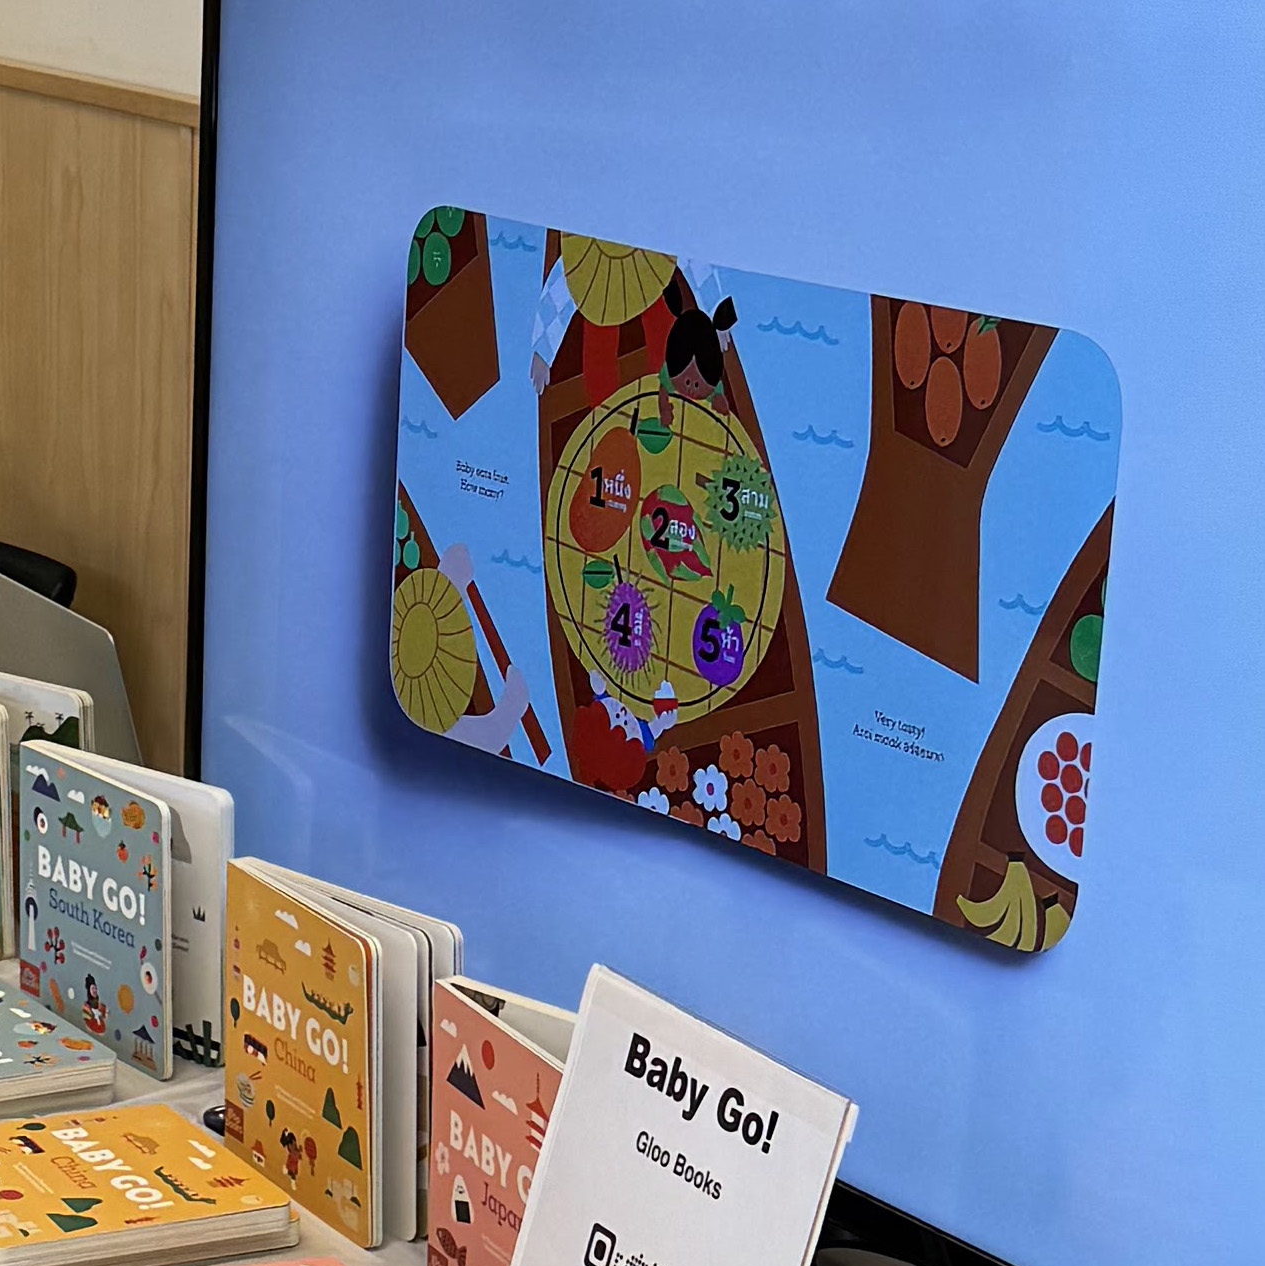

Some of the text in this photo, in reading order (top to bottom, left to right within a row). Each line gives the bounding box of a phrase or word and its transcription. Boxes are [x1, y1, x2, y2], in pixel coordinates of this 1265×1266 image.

[590, 467, 605, 508] 1
[720, 477, 741, 522] 3
[651, 507, 670, 550] 2
[610, 603, 632, 648] 4
[698, 617, 721, 663] 5
[38, 845, 145, 925] BABY GO!
[49, 888, 89, 926] South
[93, 908, 135, 947] Korea
[243, 974, 348, 1074] BABY GO!
[275, 1037, 316, 1084] China
[624, 1032, 780, 1154] Baby Go!
[50, 1127, 174, 1210] BABY GO!
[50, 1156, 97, 1189] China
[450, 1109, 512, 1188] BABY
[636, 1131, 722, 1200] Gloo Books
